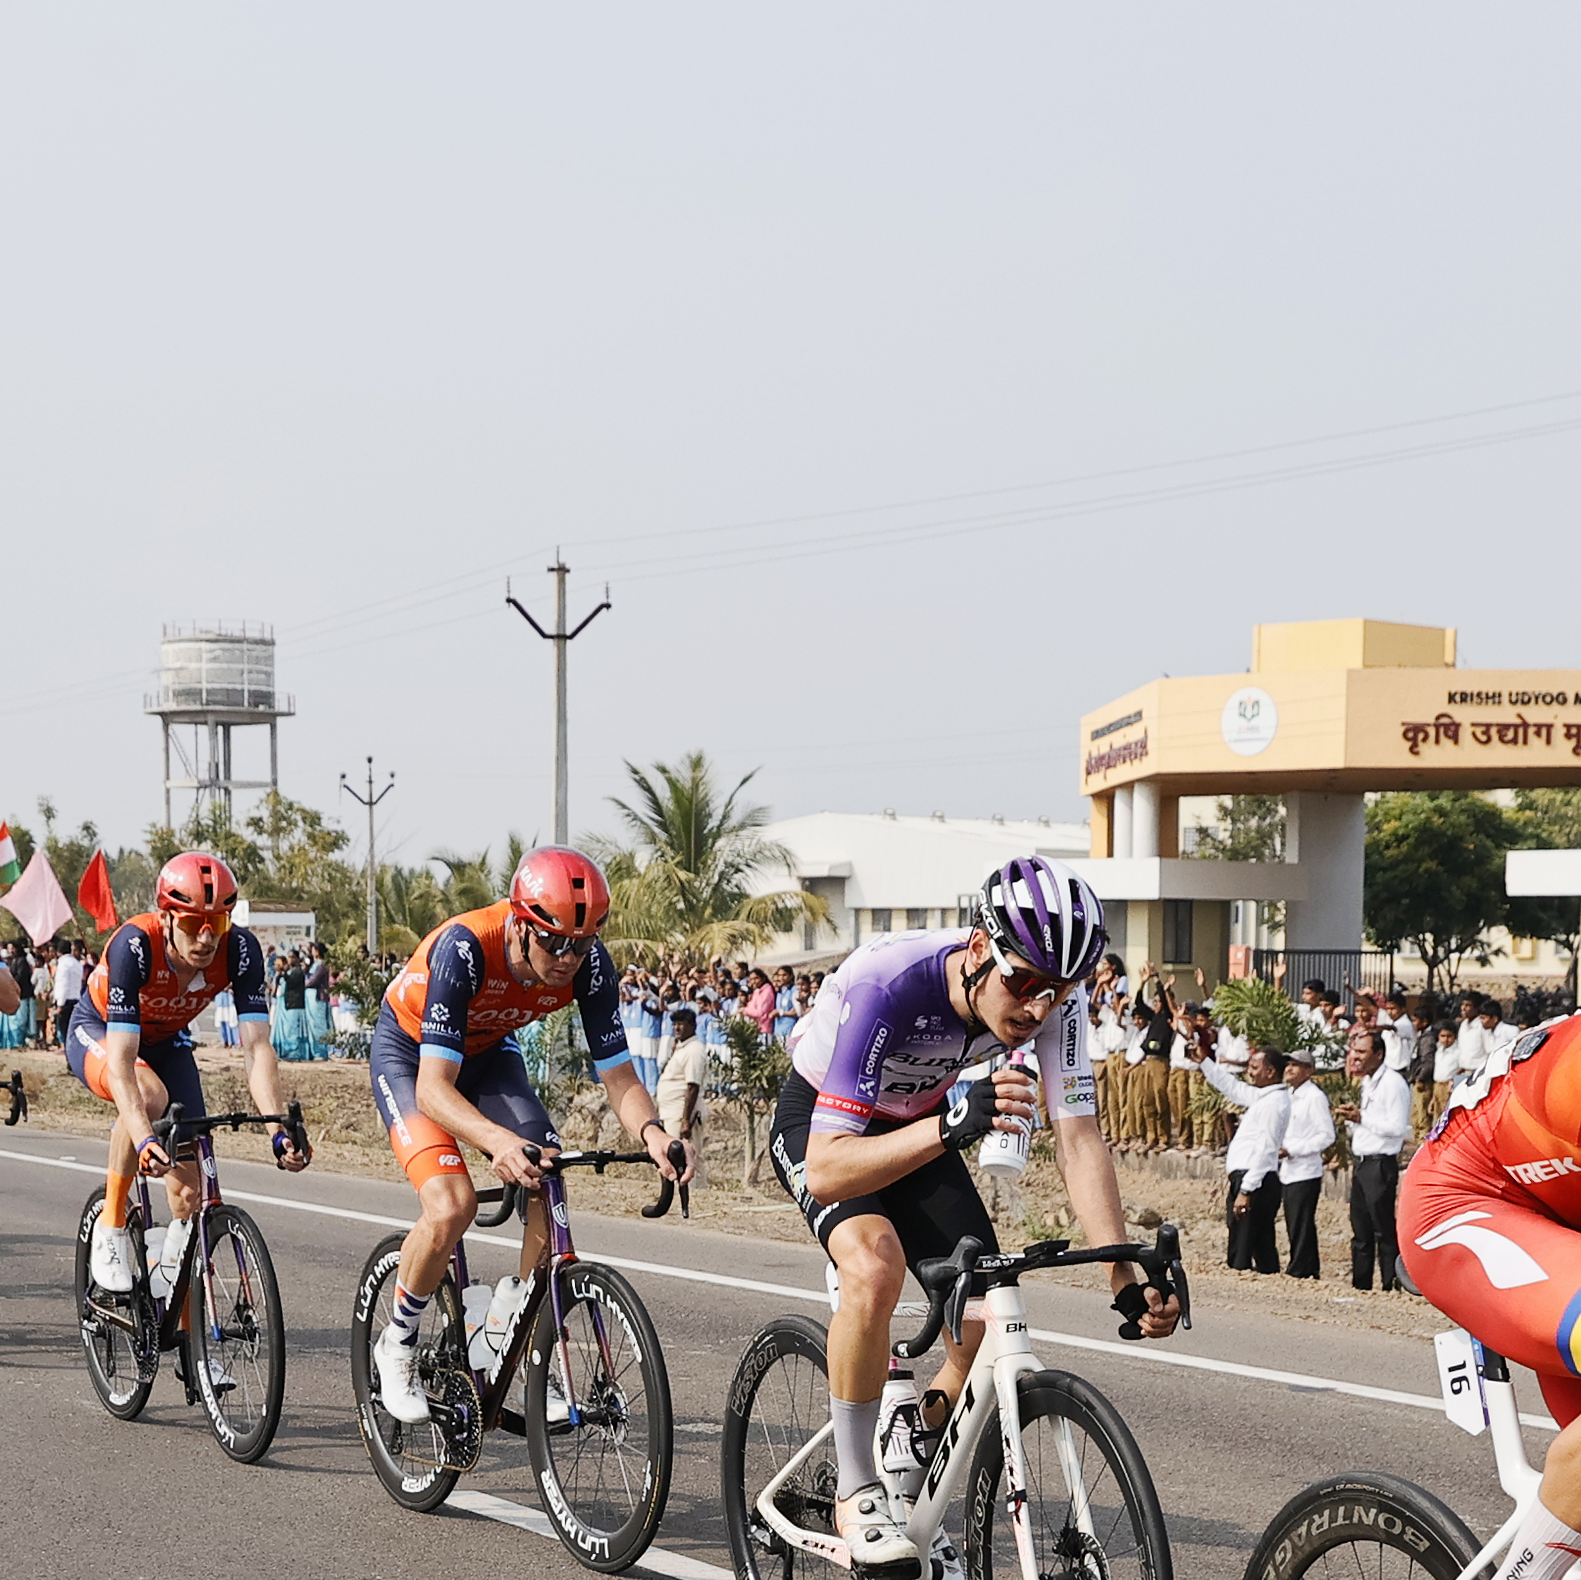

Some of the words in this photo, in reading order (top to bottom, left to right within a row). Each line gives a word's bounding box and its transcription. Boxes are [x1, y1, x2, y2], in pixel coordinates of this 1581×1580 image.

[1447, 690, 1503, 706] KRISHI
[1508, 691, 1568, 707] UDYOG
[1401, 713, 1462, 756] कृषि
[1470, 713, 1555, 747] उद्योग
[864, 1026, 889, 1076] CORTIZO
[1065, 1018, 1077, 1068] CORTIZO
[1005, 1322, 1028, 1334] BH
[1446, 1359, 1471, 1396] 16
